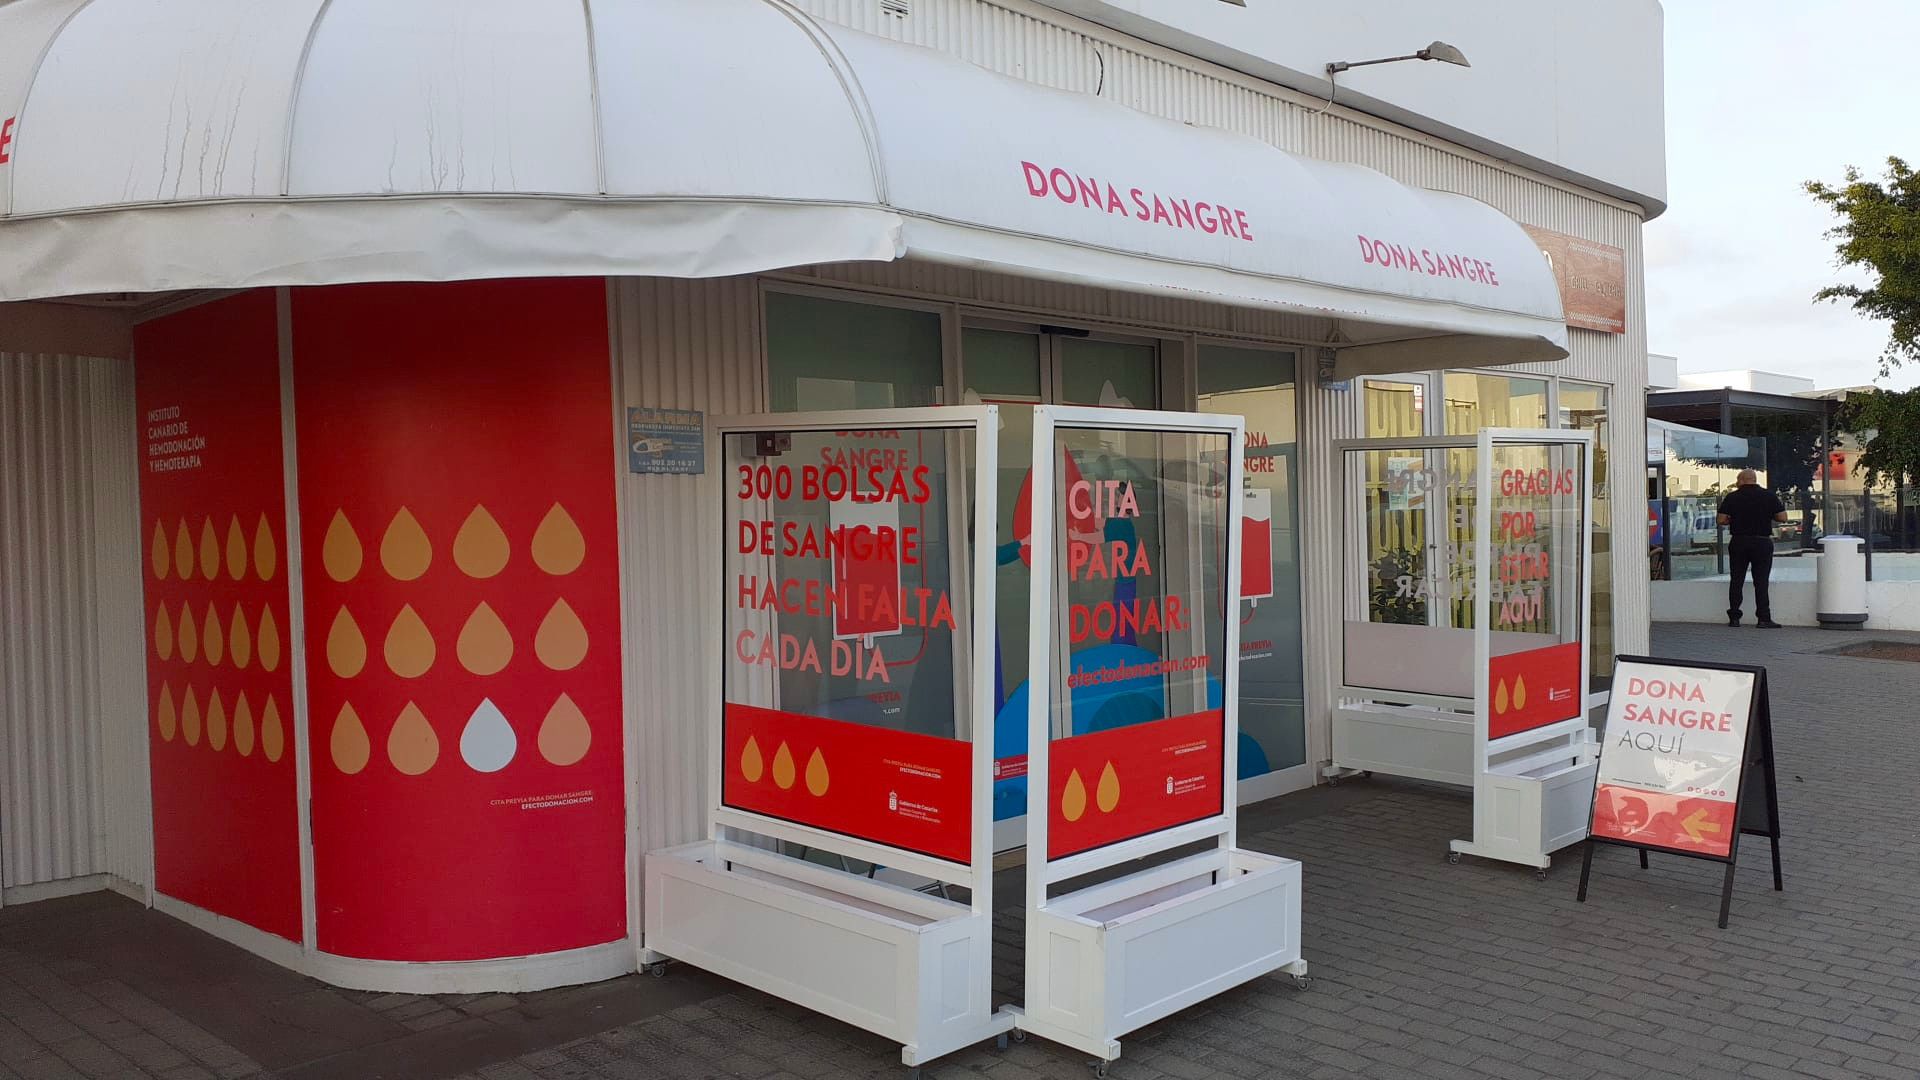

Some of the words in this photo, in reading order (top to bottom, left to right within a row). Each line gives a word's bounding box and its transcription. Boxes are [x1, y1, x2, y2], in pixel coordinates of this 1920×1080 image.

[1021, 160, 1128, 217] DONA
[1129, 188, 1253, 241] SANGRE
[1357, 234, 1422, 273] DONA
[1422, 249, 1499, 286] SANGRE
[148, 406, 180, 423] INSTITUTO
[148, 424, 179, 440] CANARIO
[179, 421, 188, 434] DE
[149, 434, 206, 456] HEMODONACIÓN
[149, 460, 155, 472] Y
[155, 454, 201, 472] HEMOTERAPIA
[738, 464, 792, 501] 300
[802, 464, 931, 504] BOLSAS
[1069, 479, 1141, 519] CITA
[1500, 468, 1574, 497] GRACIAS
[739, 519, 775, 556] DE
[783, 521, 920, 565] SANGRE
[1501, 511, 1536, 540] POR
[1070, 538, 1152, 583] PARA
[1501, 551, 1549, 585] ESTAR
[738, 574, 849, 618] HACEN
[857, 582, 957, 631] FALTA
[1069, 595, 1190, 644] DONAR:
[736, 629, 823, 674] CADA
[831, 631, 890, 683] DÍA
[1067, 653, 1211, 689] efectodonacion.com
[1628, 677, 1705, 703] DONA
[1623, 703, 1733, 732] SANGRE
[1618, 729, 1685, 755] AQUÍ
[521, 796, 594, 810] EFECTODONACION.COM
